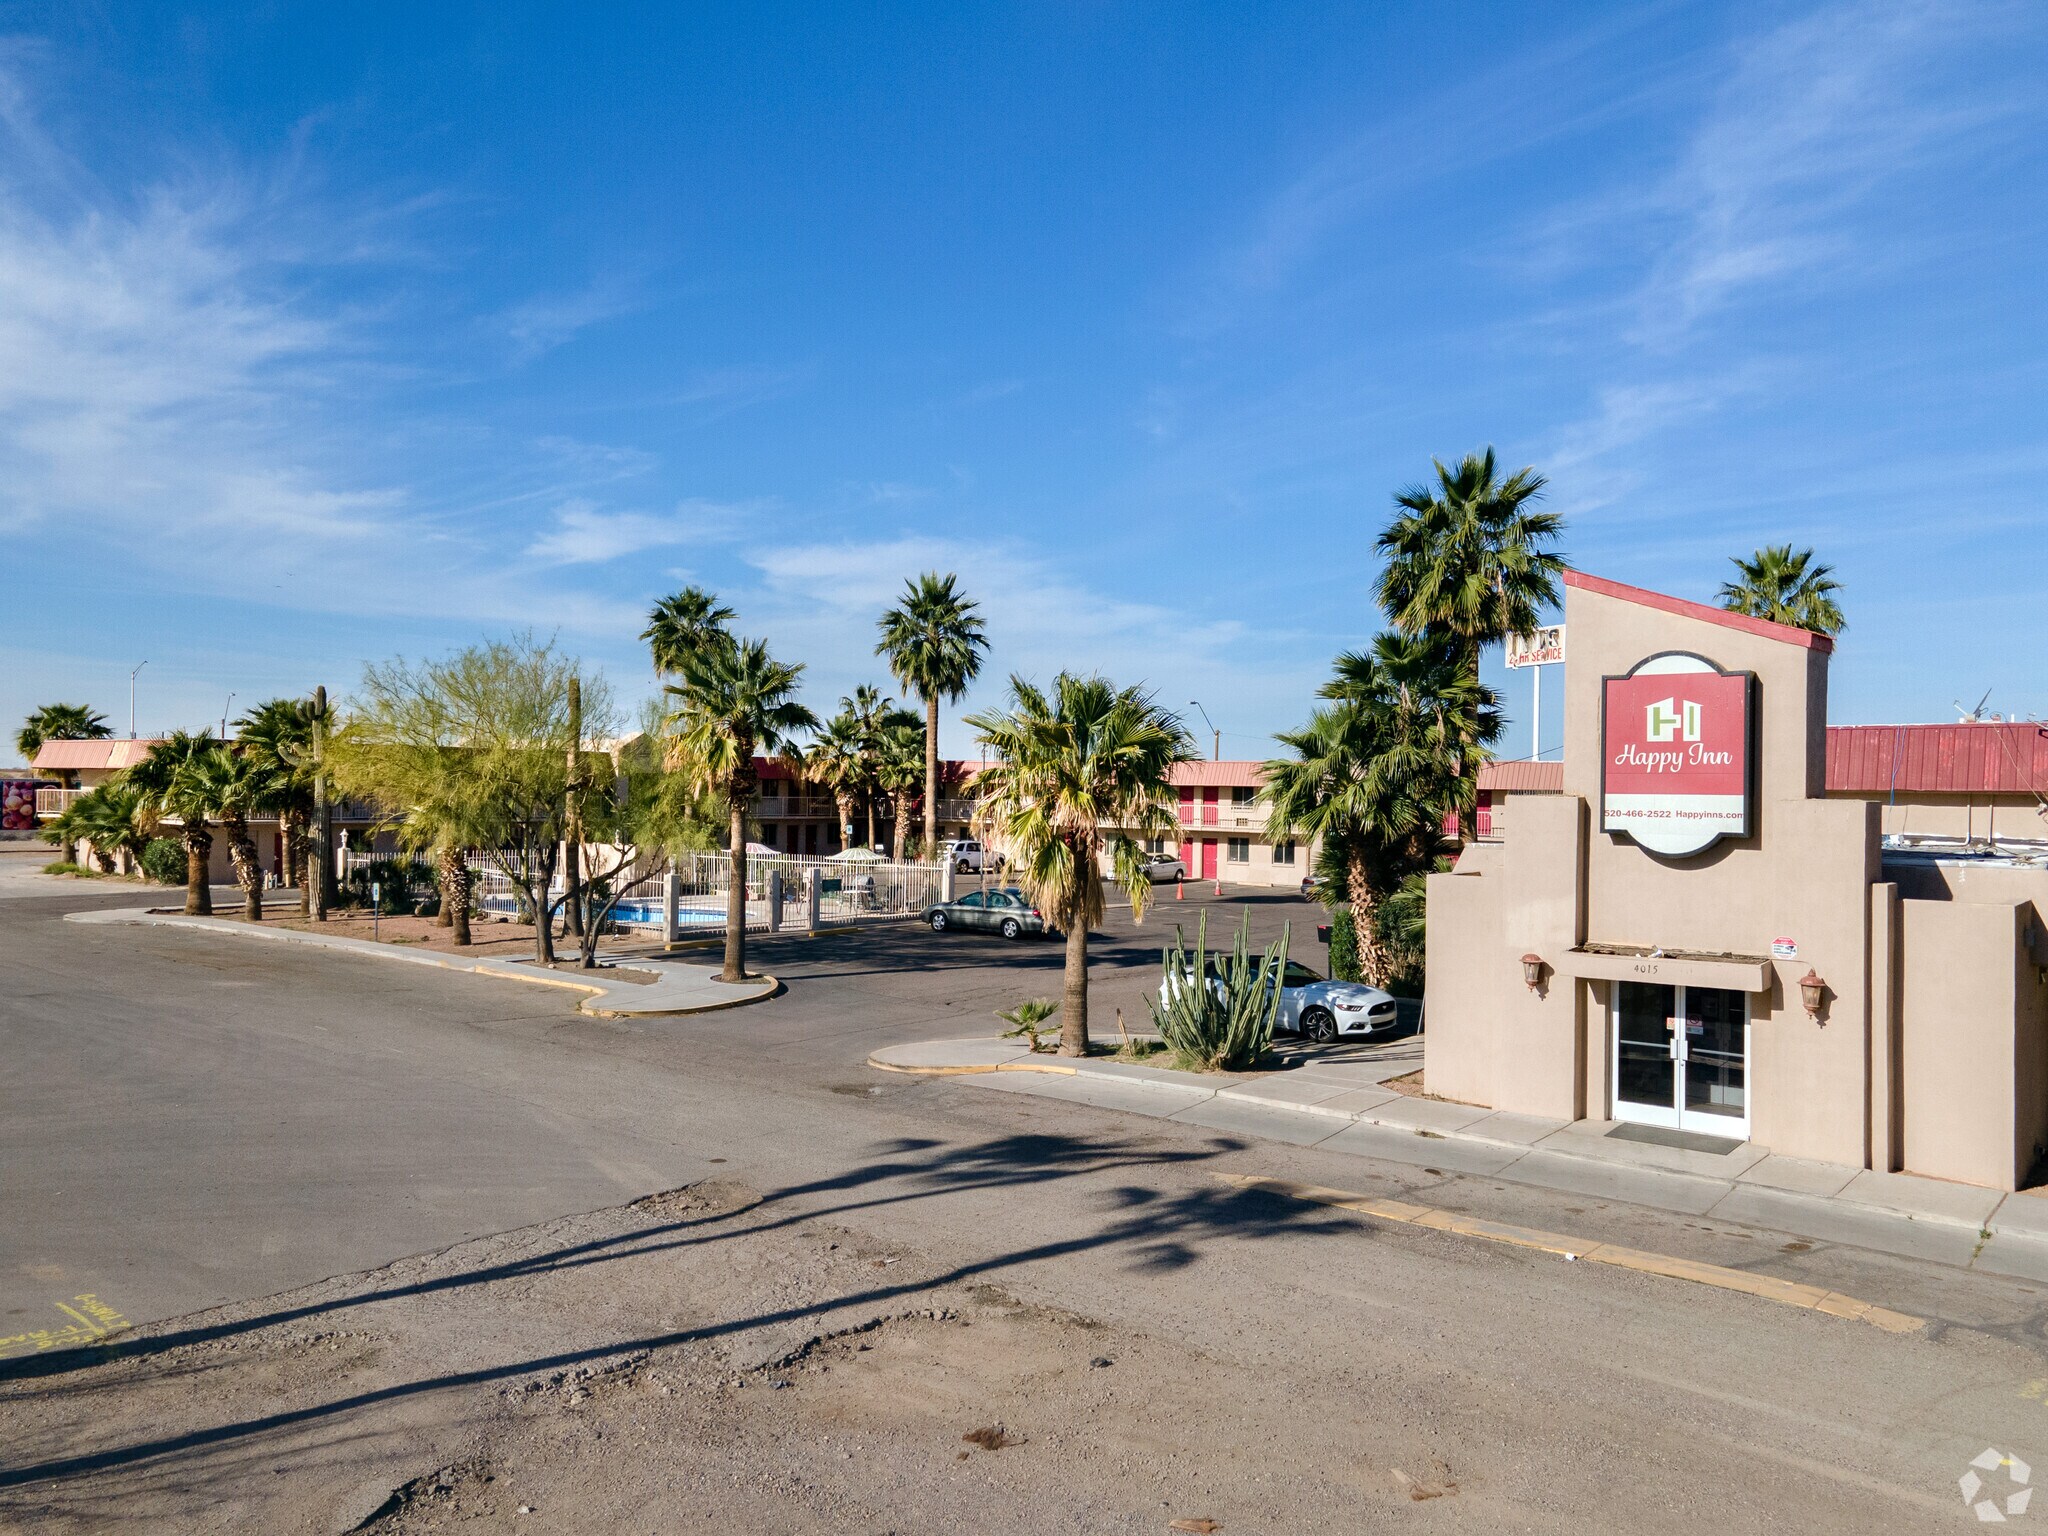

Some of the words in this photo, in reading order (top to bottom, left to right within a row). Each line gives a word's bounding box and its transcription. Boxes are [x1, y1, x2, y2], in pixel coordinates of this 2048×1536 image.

[1615, 744, 1684, 773] Happy
[1688, 742, 1733, 765] Inn
[1604, 810, 1671, 818] 520-466-2522
[1634, 964, 1659, 975] 4015
